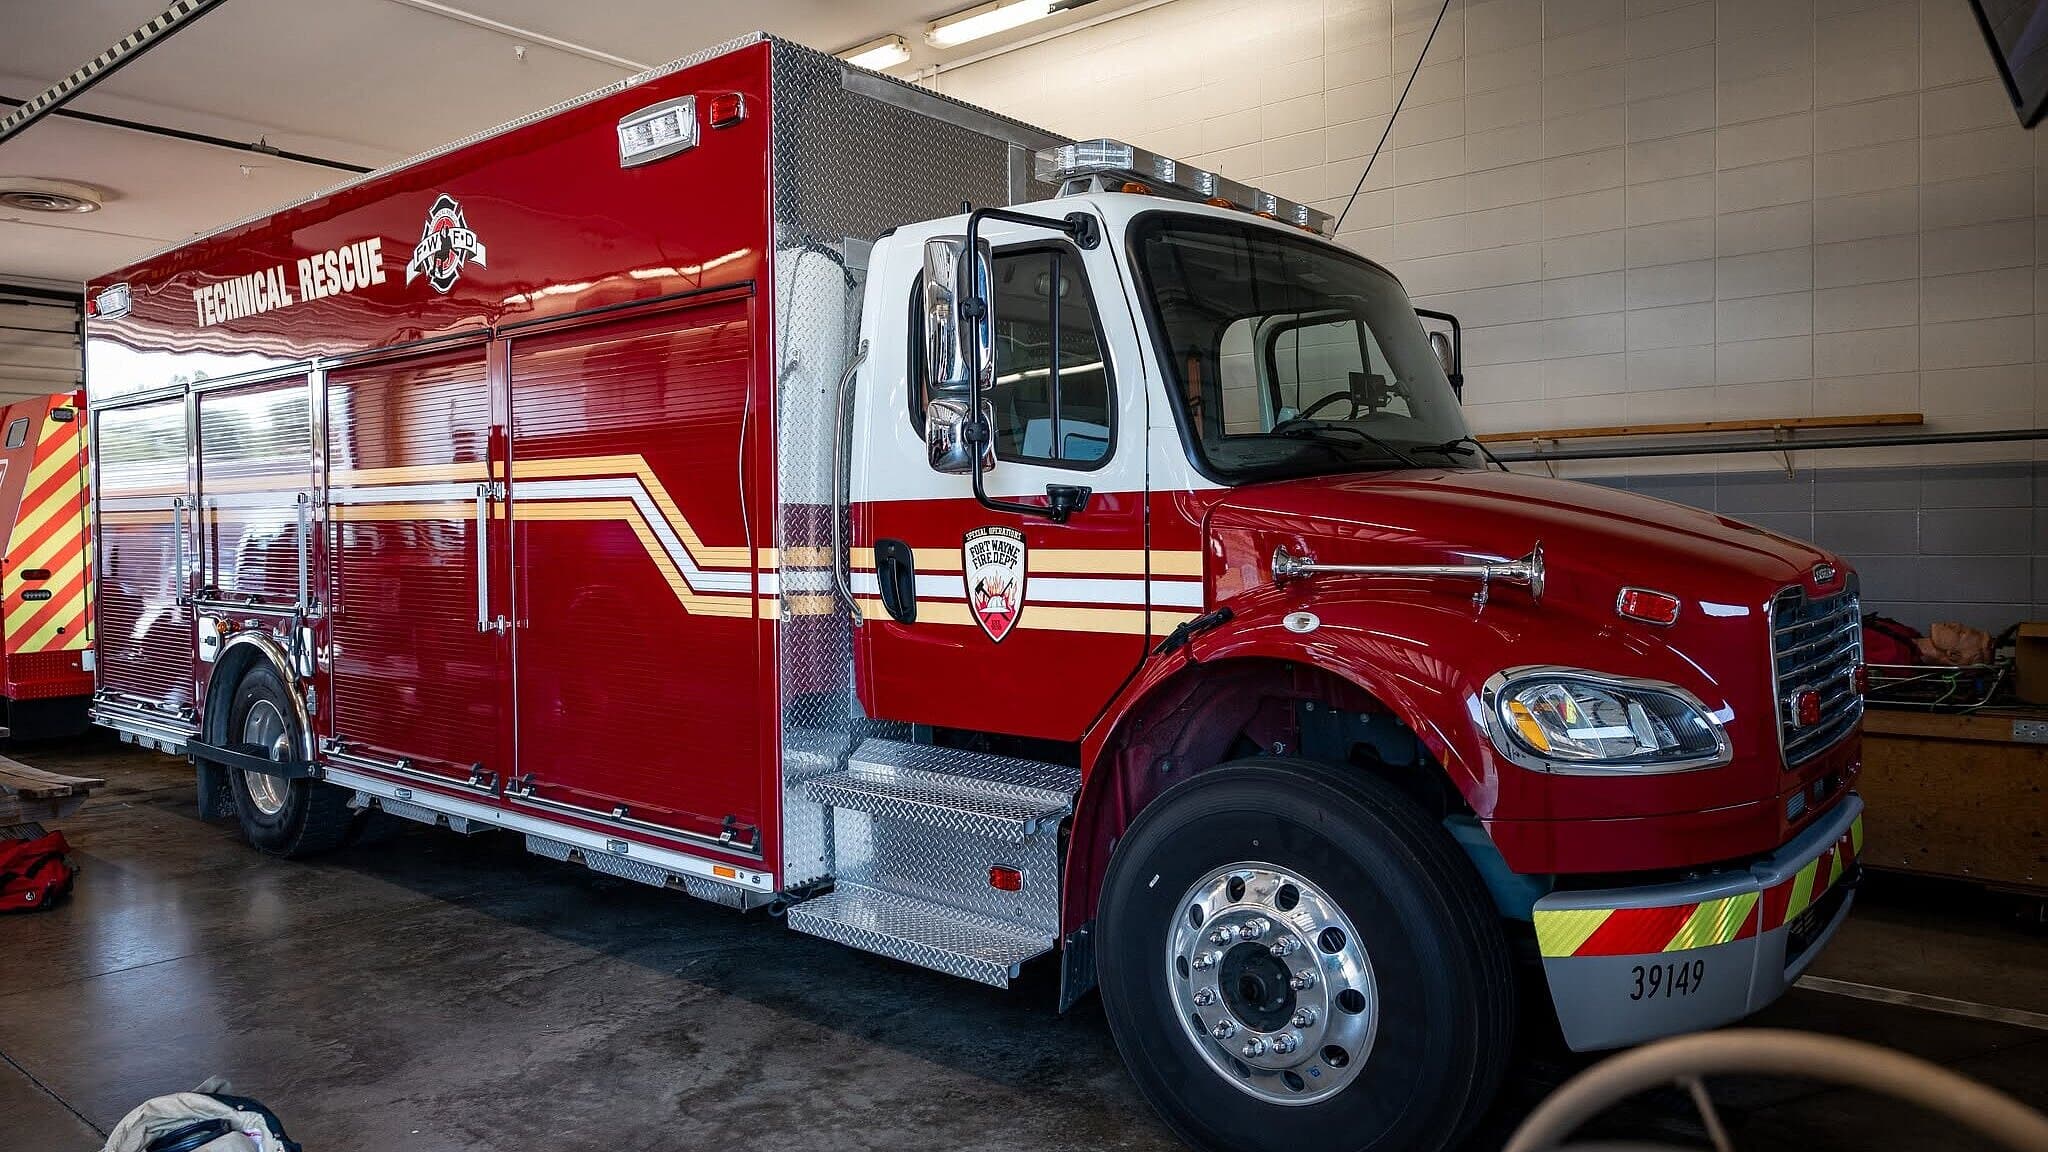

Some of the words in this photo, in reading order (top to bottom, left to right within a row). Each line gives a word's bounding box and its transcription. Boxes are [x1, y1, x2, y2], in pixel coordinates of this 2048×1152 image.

[193, 265, 293, 328] TECHNICAL
[297, 237, 386, 303] RESCUE
[965, 527, 988, 541] SPECIAL
[988, 527, 1022, 540] OPERATIONS
[969, 540, 991, 559] FORT
[991, 540, 1020, 559] WAYNE
[972, 551, 993, 570] FIRE
[993, 552, 1018, 570] DEPT
[1630, 960, 1704, 1001] 39149
